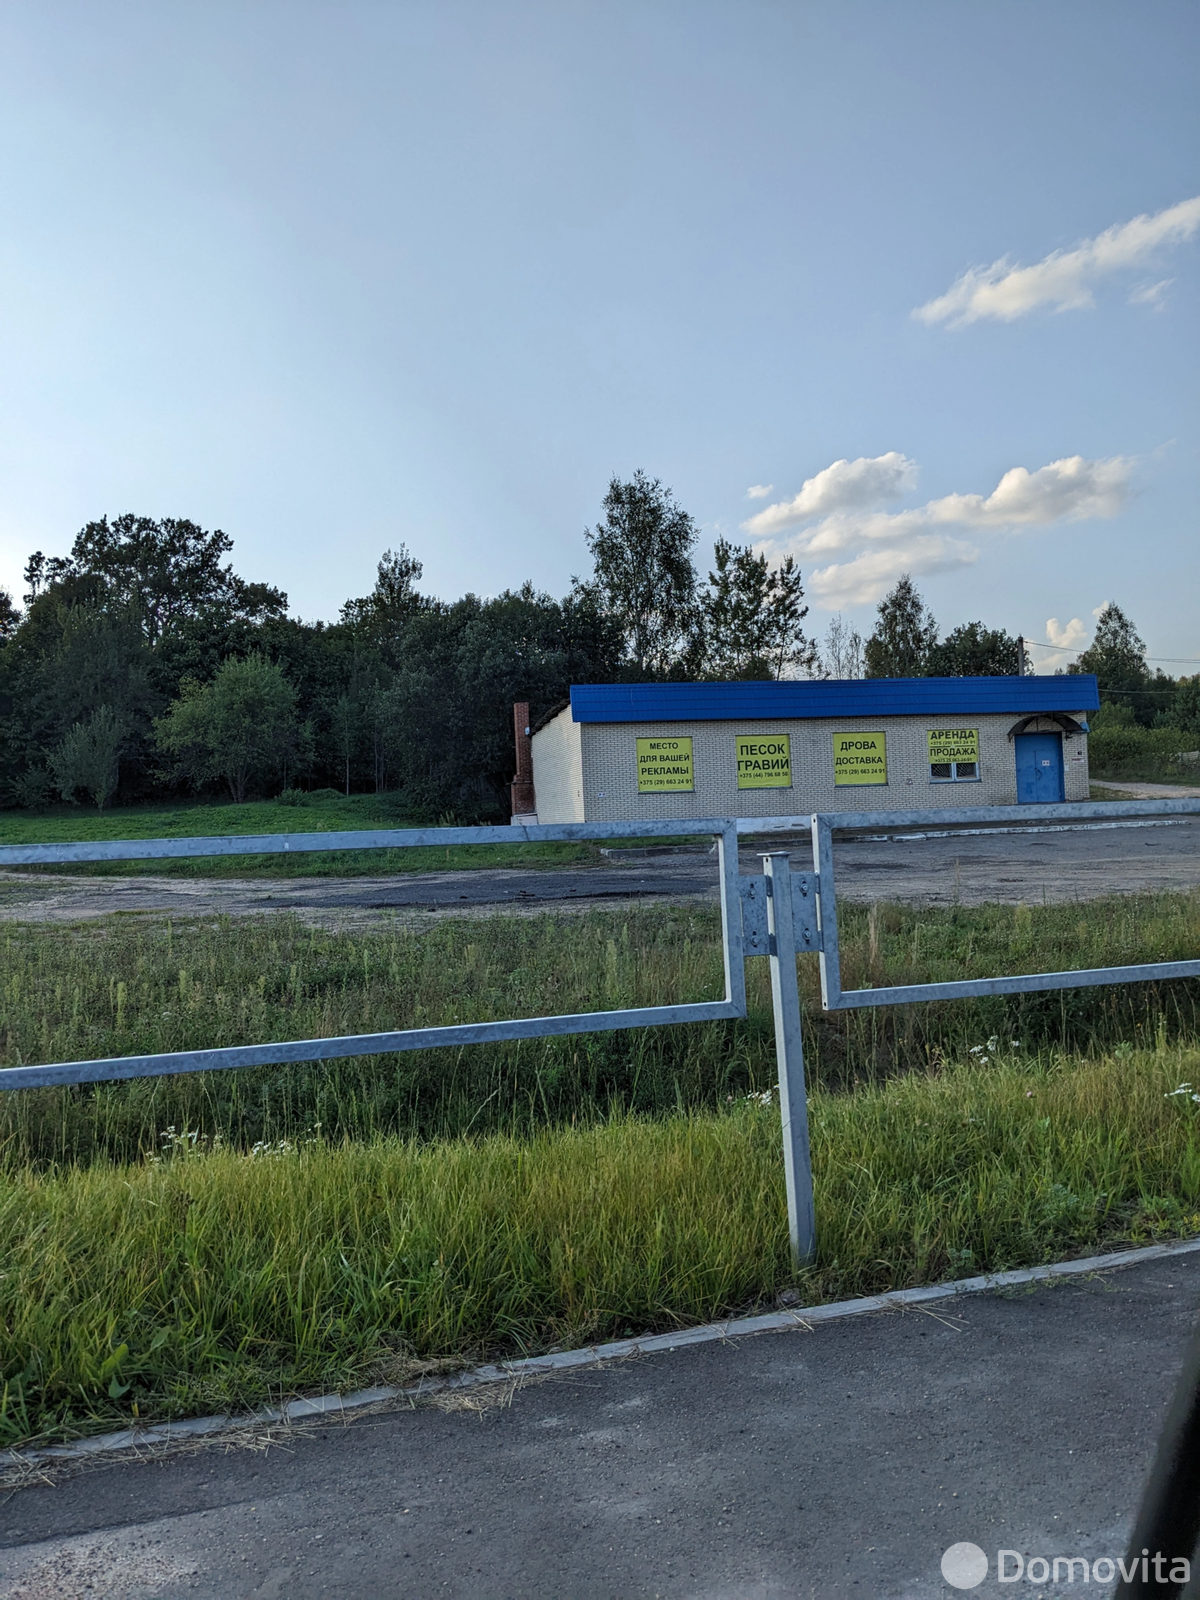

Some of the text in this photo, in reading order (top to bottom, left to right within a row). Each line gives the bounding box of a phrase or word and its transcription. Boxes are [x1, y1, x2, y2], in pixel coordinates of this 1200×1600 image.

[930, 731, 974, 740] АРЕНДА
[649, 742, 679, 750] МЕСТО
[740, 743, 785, 756] ПЕСОК
[840, 741, 877, 752] ДРОВА
[930, 747, 976, 757] ПРОДАЖА
[640, 753, 690, 763] ДЛЯ ВАШЕЙ
[835, 756, 883, 766] ДОСТАВКА
[737, 756, 789, 771] ГРАВИЙ
[641, 766, 689, 775] РЕКЛАМЫ
